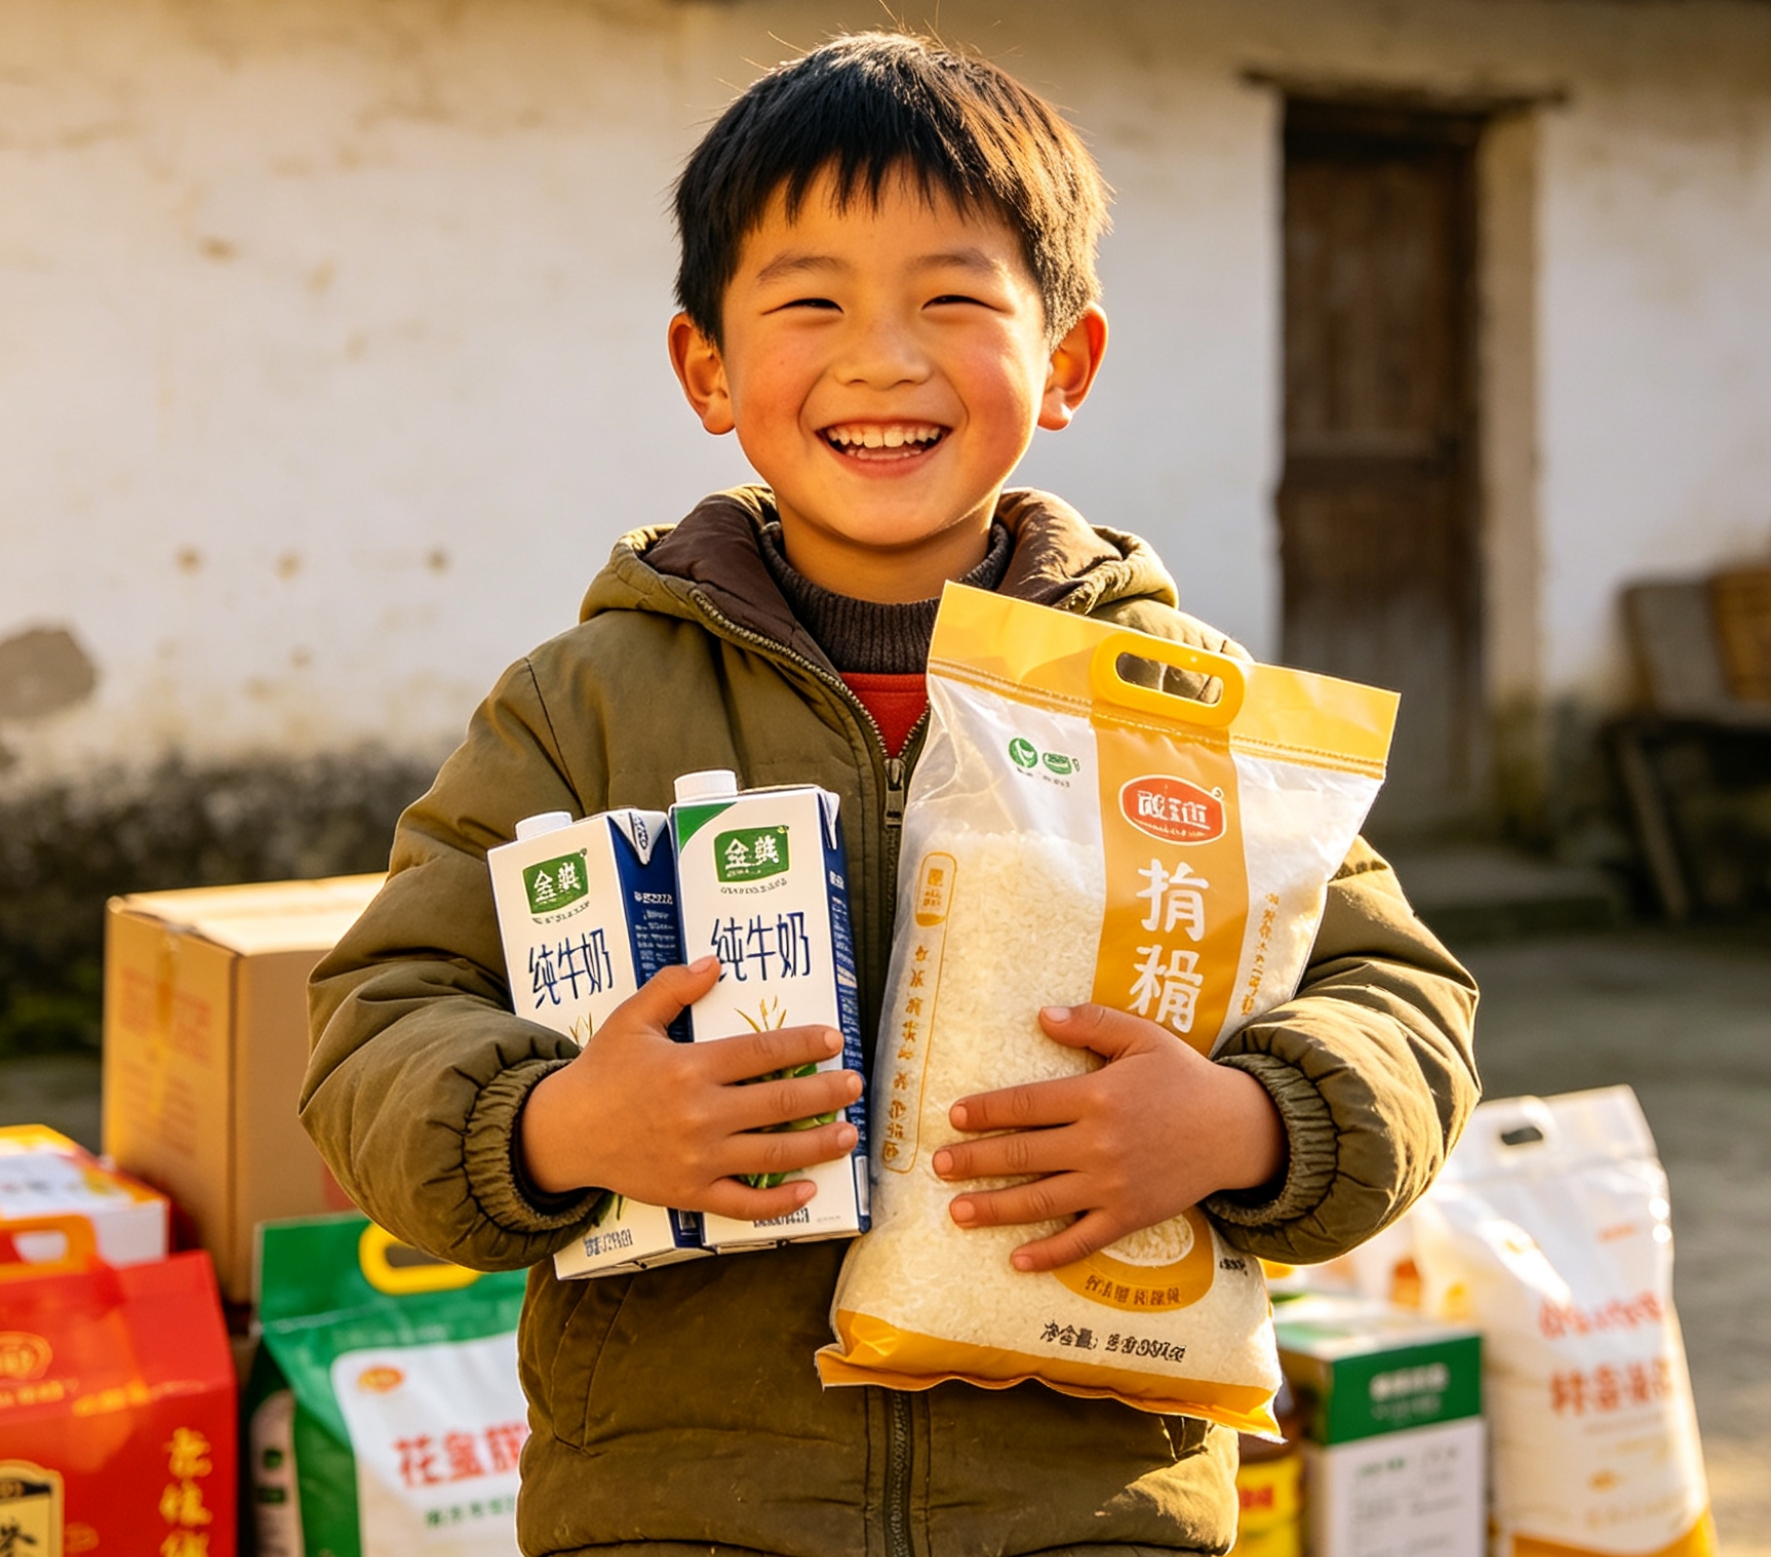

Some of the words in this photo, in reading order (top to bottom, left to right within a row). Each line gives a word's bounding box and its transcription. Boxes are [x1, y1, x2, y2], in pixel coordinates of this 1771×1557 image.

[528, 928, 613, 1009] 纯牛奶
[711, 911, 810, 983] 纯牛奶
